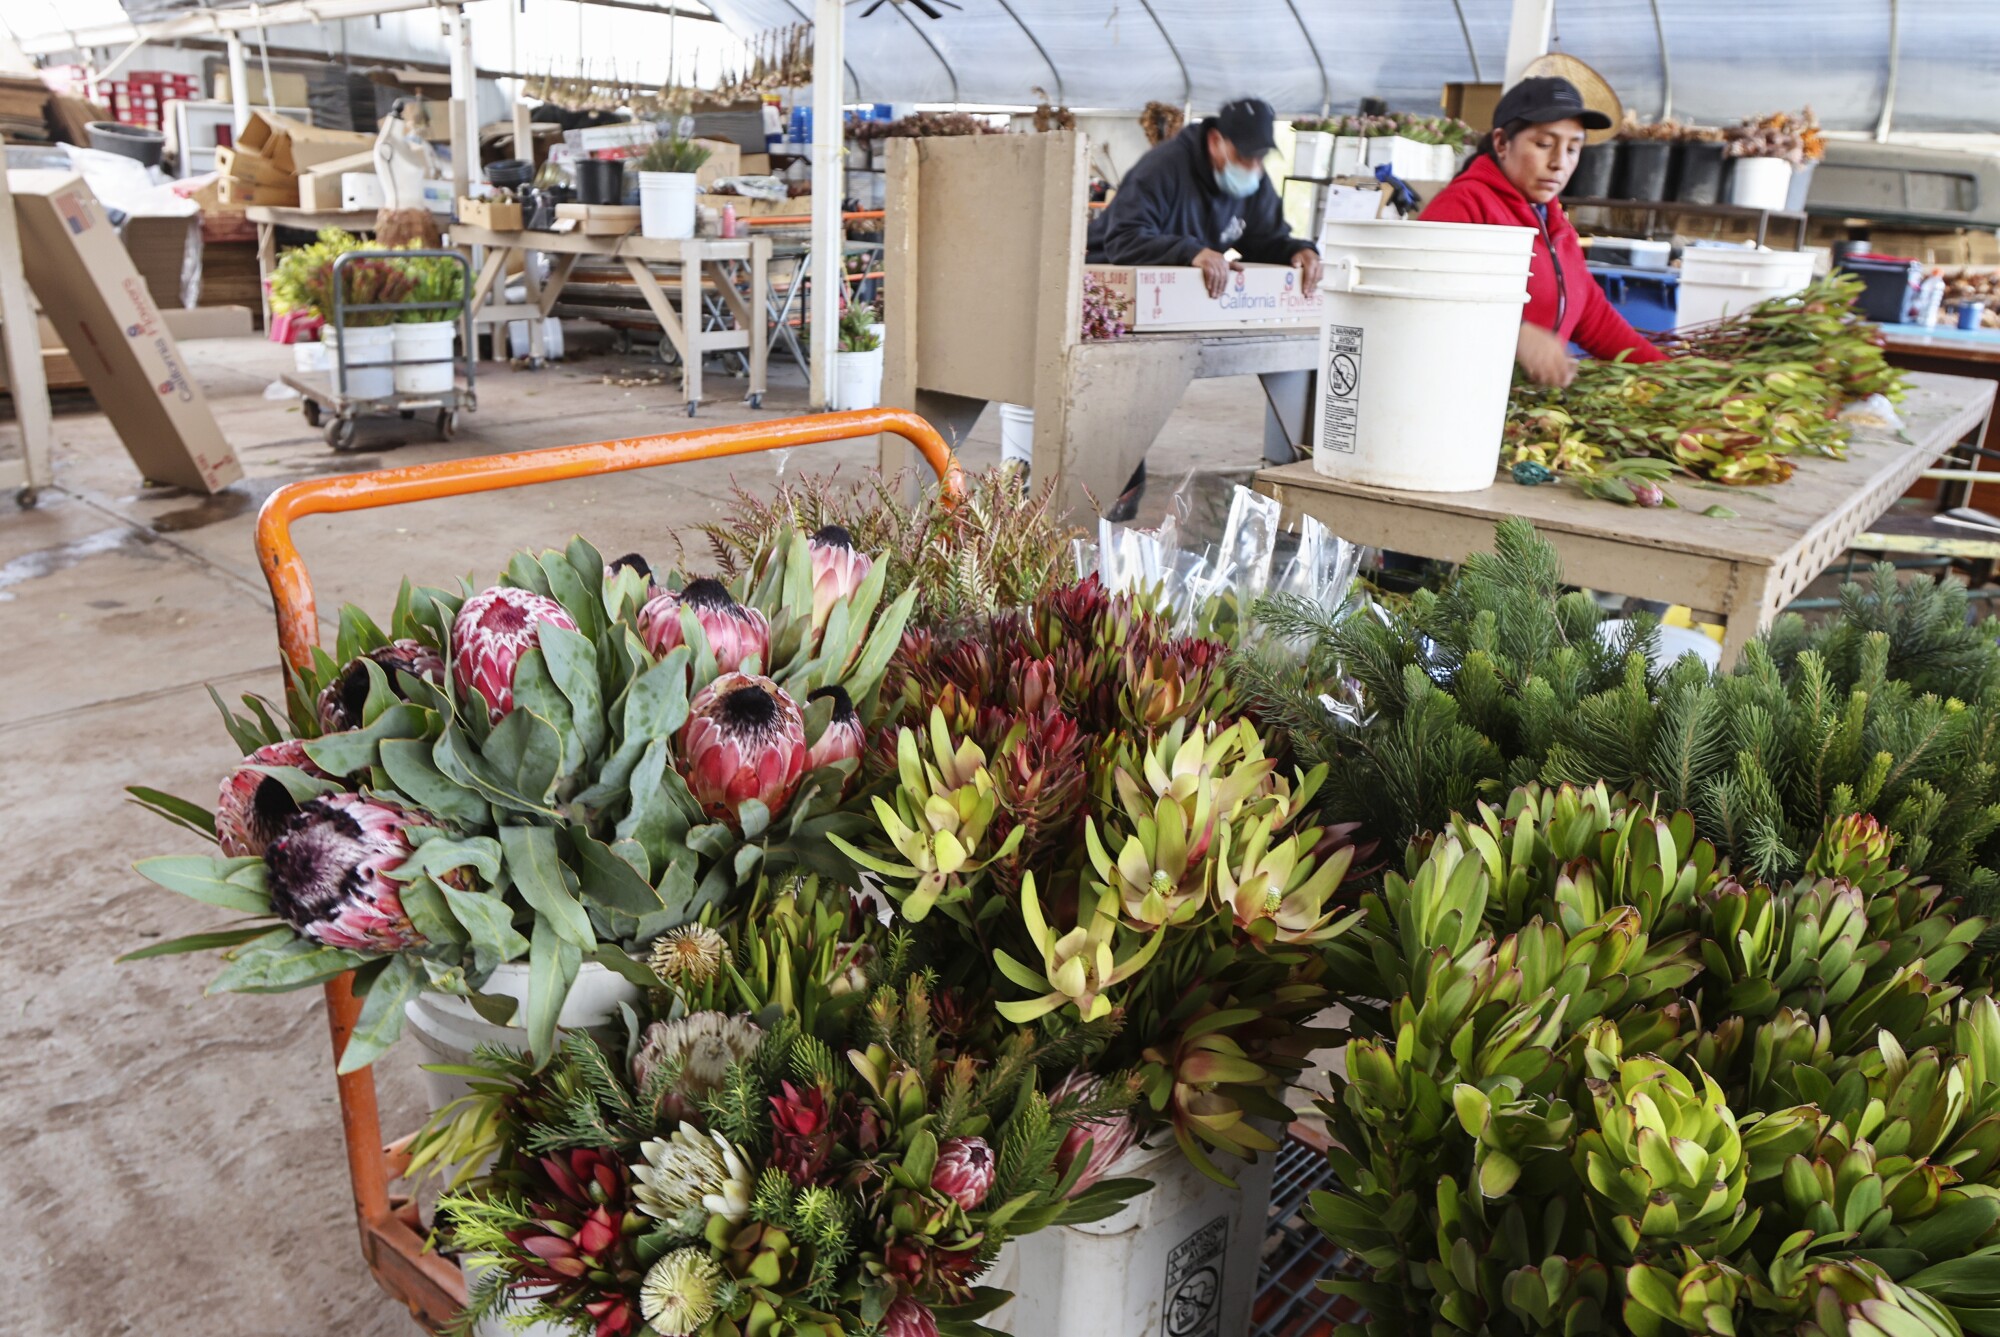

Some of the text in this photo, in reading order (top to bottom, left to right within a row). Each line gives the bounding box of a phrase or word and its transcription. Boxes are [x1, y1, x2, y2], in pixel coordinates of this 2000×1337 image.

[1110, 272, 1128, 284] SIDE
[1140, 272, 1176, 284] THIS SIDE
[1220, 292, 1323, 309] California Flowers
[122, 277, 193, 401] California Flowers
[1336, 327, 1362, 337] WARNING
[1339, 336, 1355, 345] AVISO
[1180, 1216, 1227, 1254] WARNING
[1189, 1234, 1217, 1259] AVISO
